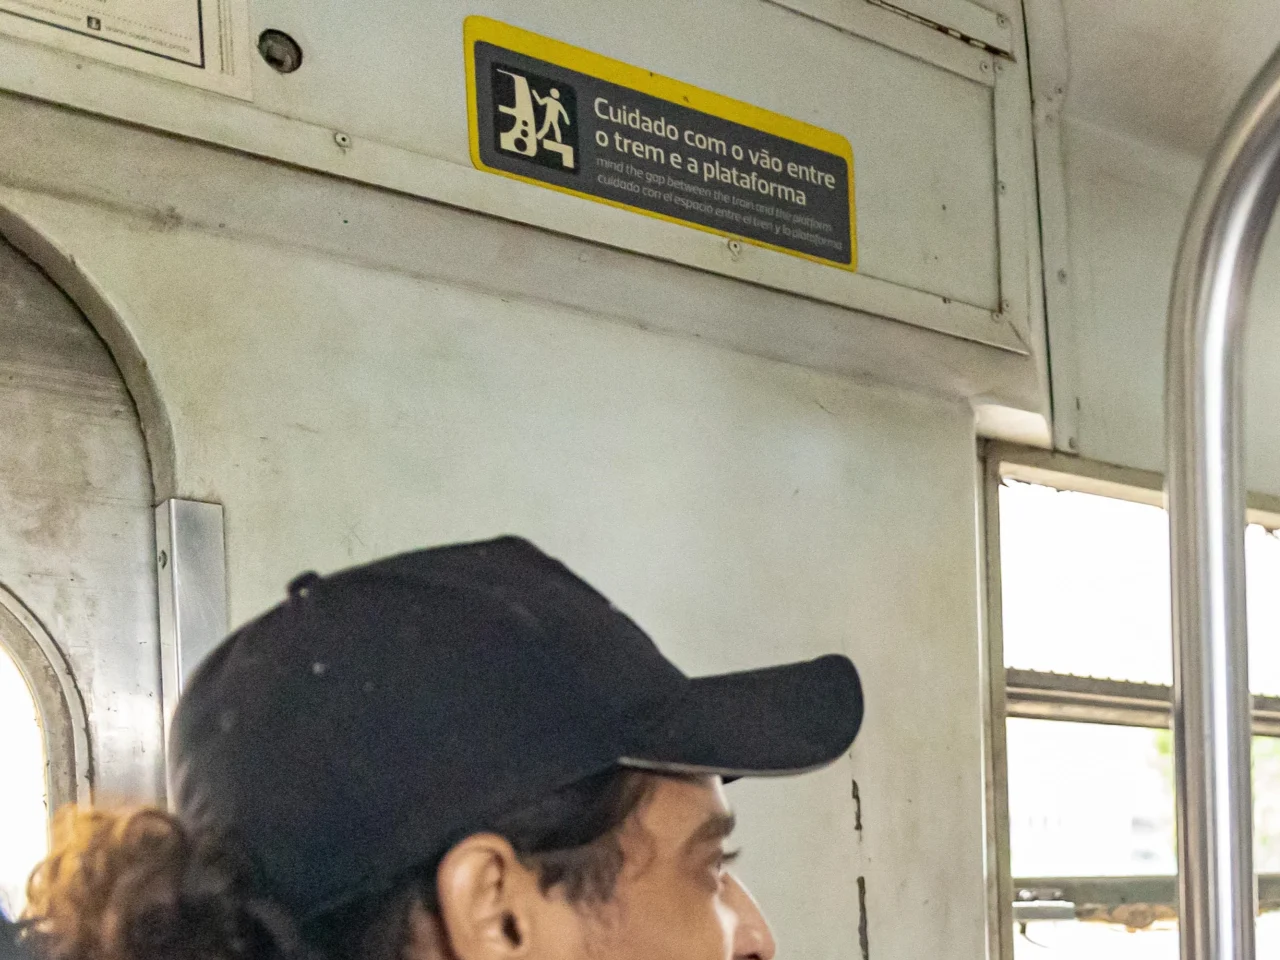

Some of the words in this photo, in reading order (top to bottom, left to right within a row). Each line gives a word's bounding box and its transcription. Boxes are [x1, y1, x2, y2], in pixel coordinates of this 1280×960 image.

[594, 97, 679, 141] Cuidado
[684, 130, 727, 156] com
[732, 145, 744, 160] o
[748, 149, 783, 172] vão
[787, 162, 836, 189] entre
[595, 130, 609, 147] o
[614, 131, 665, 164] trem
[670, 152, 682, 169] e
[687, 157, 699, 174] a
[703, 160, 807, 206] plataforma
[596, 158, 624, 174] mind
[625, 164, 644, 179] the
[645, 172, 666, 186] gap
[667, 176, 712, 197] between
[713, 189, 730, 203] the
[597, 174, 640, 194] cuidado
[642, 186, 661, 200] con
[663, 191, 673, 202] el
